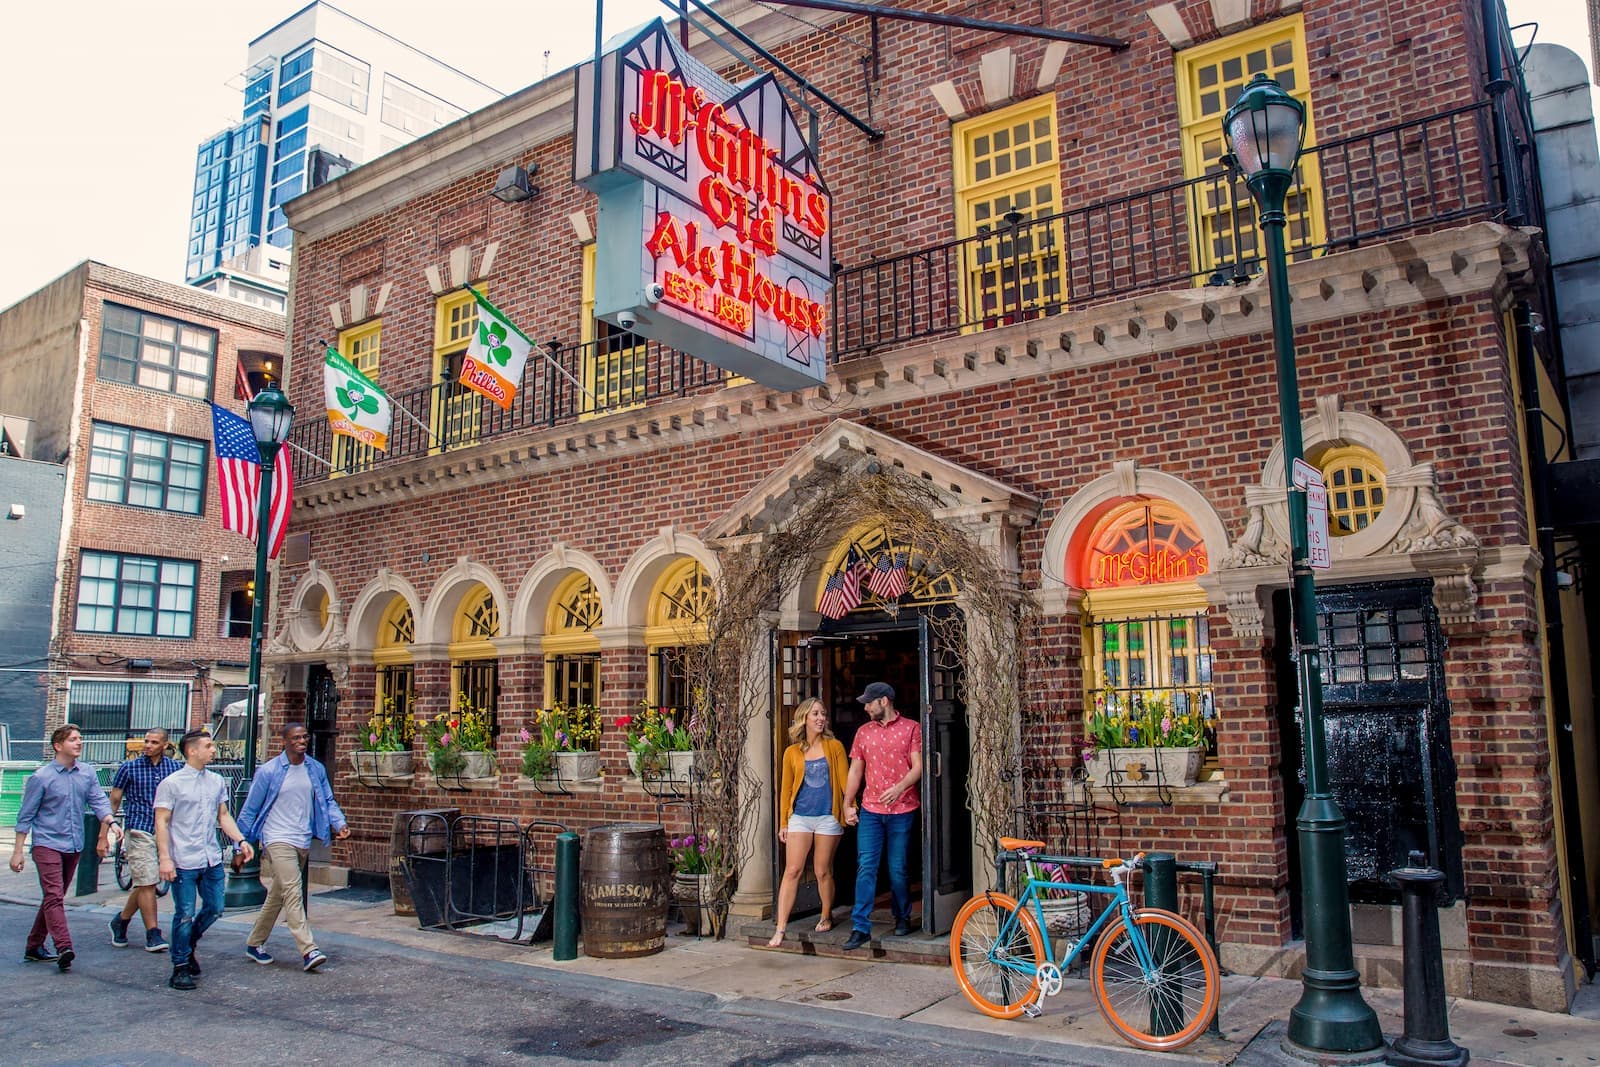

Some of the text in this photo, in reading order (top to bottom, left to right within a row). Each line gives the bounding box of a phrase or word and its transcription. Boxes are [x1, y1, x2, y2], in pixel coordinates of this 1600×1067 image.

[629, 68, 828, 238] McGillin's
[699, 175, 779, 256] Old
[714, 293, 752, 332] 1860
[460, 359, 506, 401] Phillies
[1096, 547, 1208, 584] McGillin's
[1312, 547, 1327, 561] EET
[591, 884, 652, 899] JAMESON
